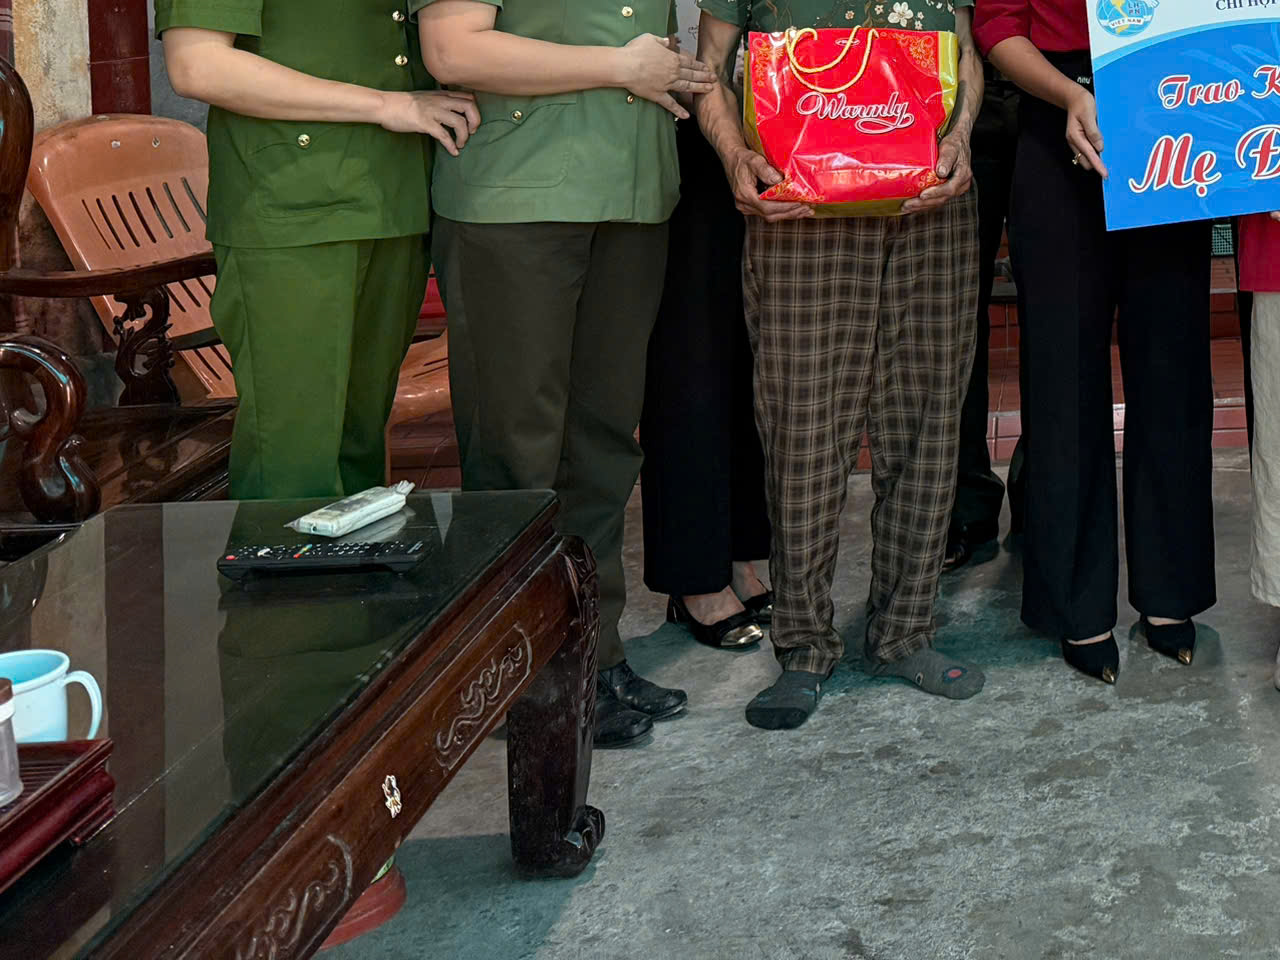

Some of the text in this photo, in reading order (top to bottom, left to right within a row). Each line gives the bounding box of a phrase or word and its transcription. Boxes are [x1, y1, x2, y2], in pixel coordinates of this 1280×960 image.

[796, 91, 915, 134] Warmly
[1158, 74, 1244, 109] Trao
[1128, 133, 1222, 197] Mẹ
